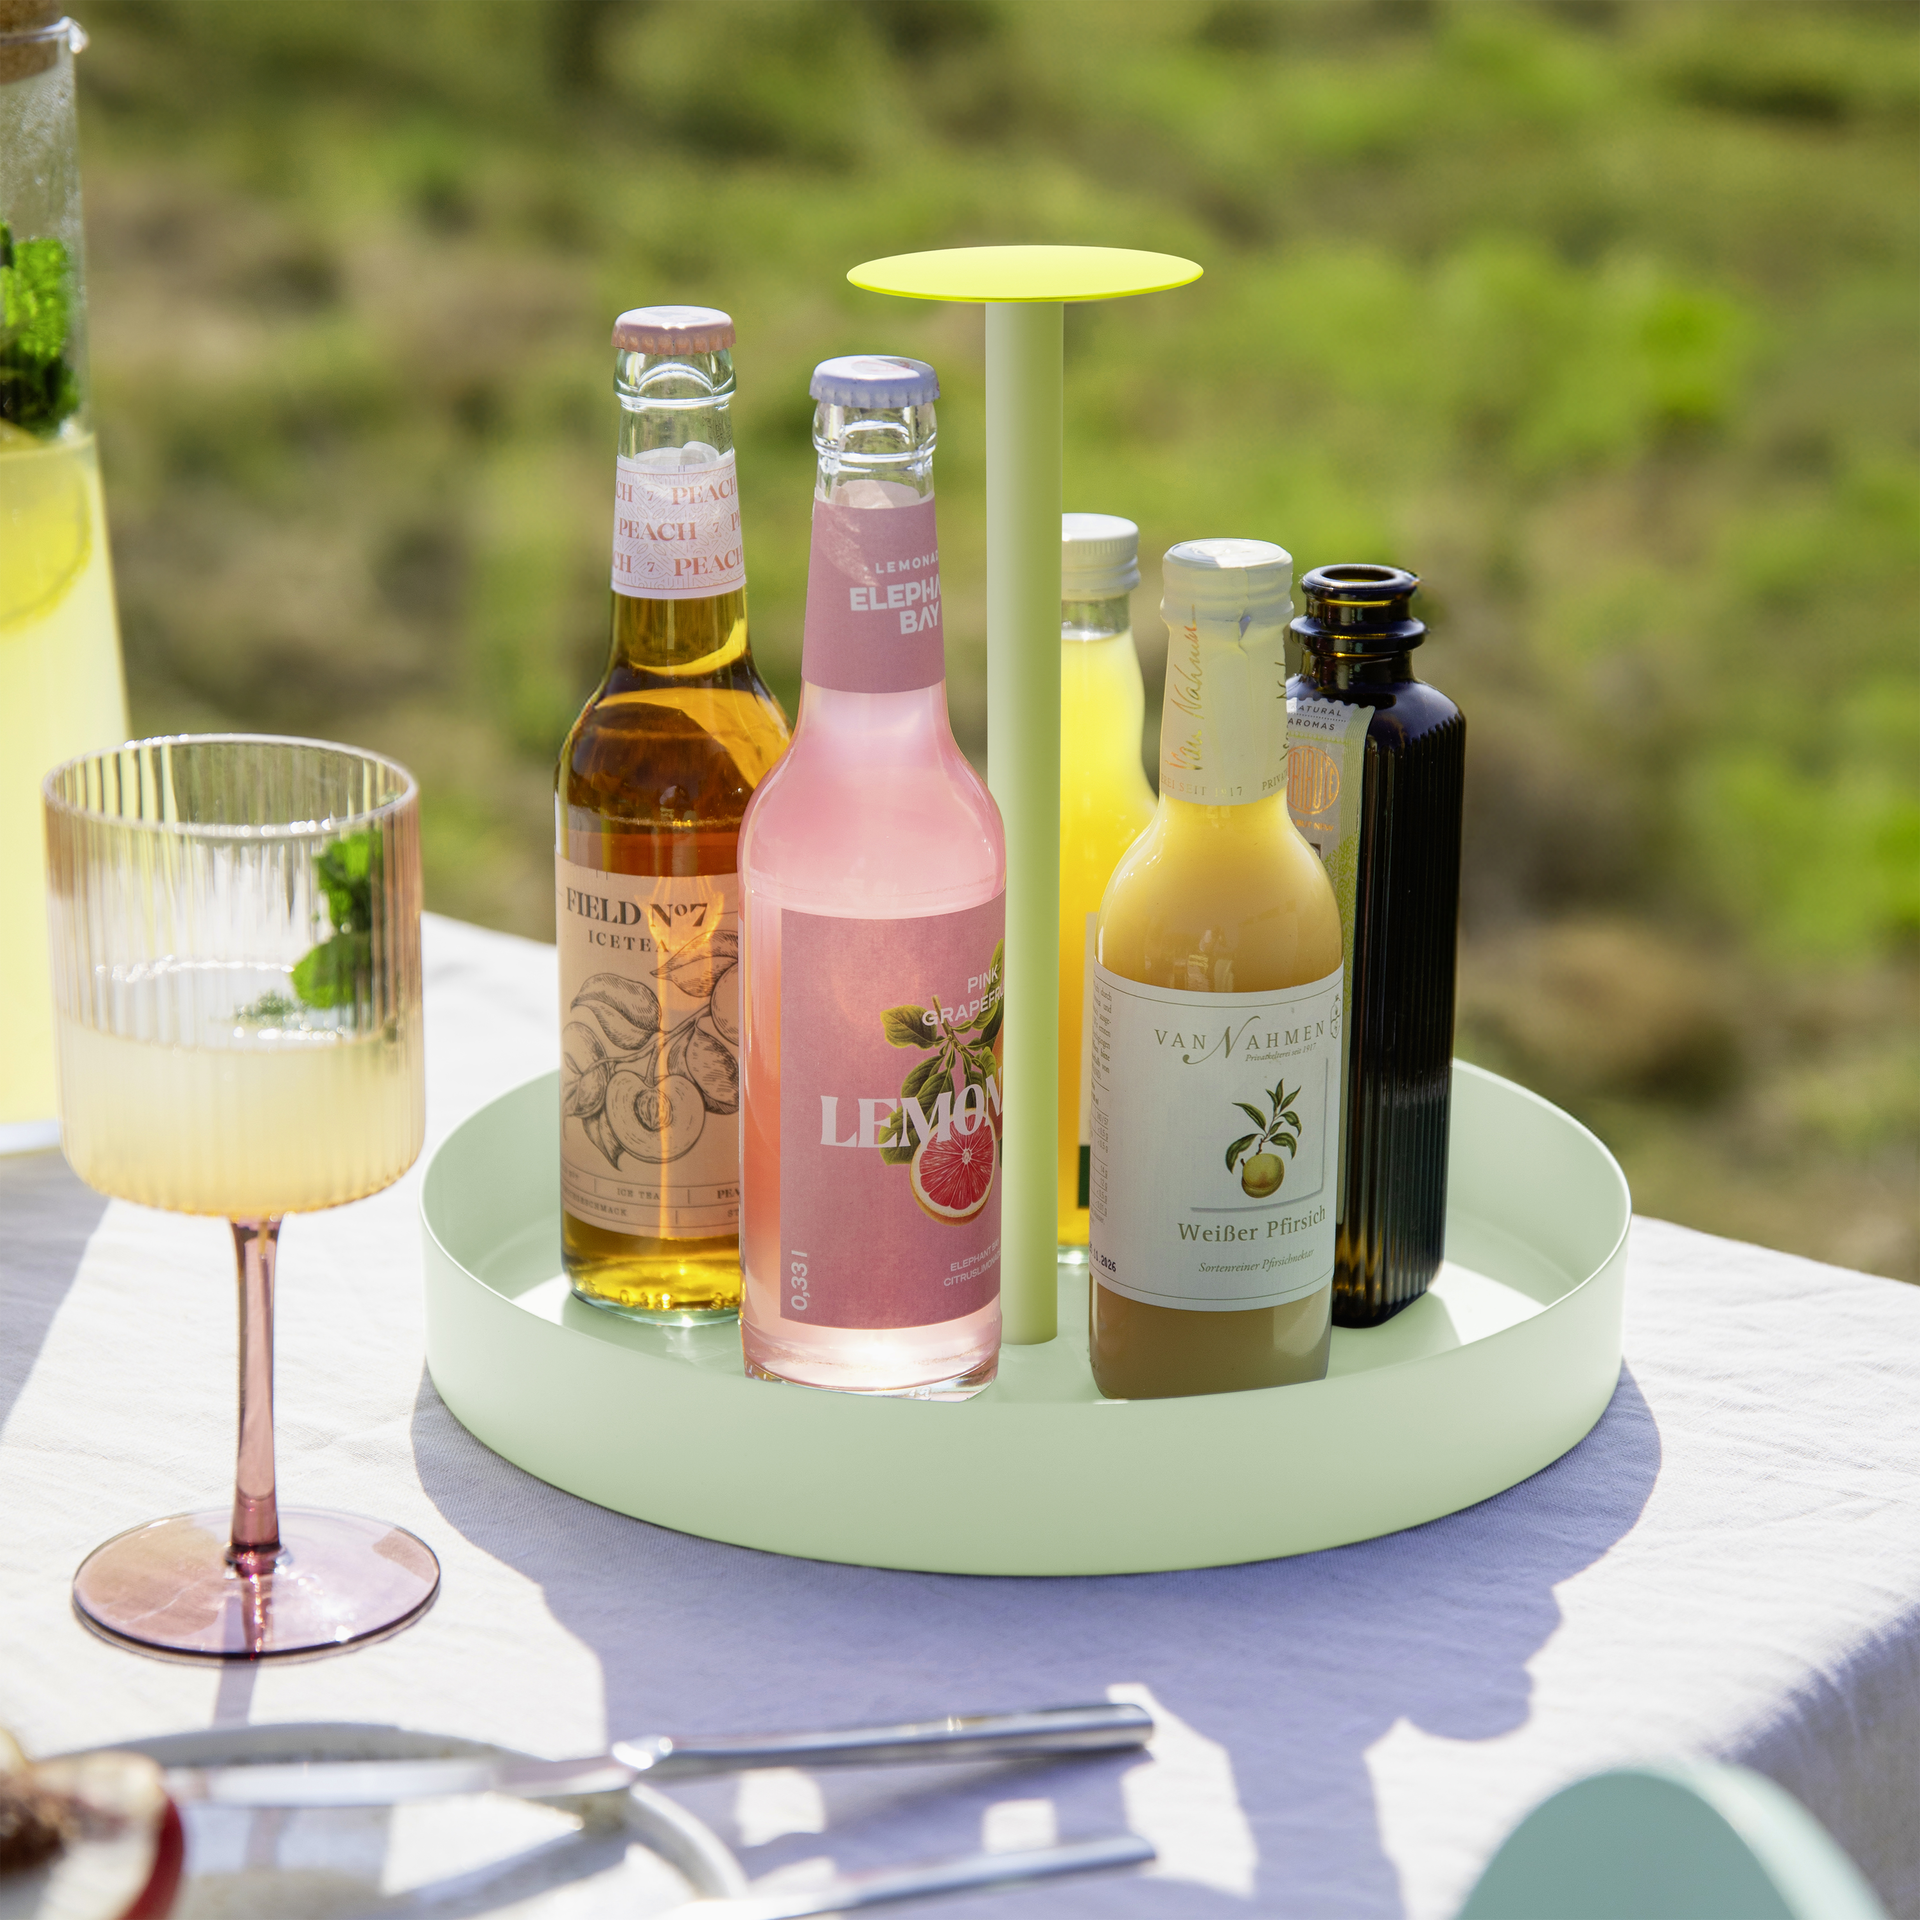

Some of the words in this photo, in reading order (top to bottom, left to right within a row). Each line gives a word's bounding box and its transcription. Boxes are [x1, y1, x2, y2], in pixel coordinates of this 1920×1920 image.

[647, 491, 655, 501] 7
[672, 475, 737, 505] PEACH
[619, 517, 697, 541] PEACH
[713, 522, 719, 533] 7
[647, 562, 655, 572] 7
[674, 545, 743, 576] PEACH
[900, 601, 939, 635] BAY
[1288, 717, 1335, 731] AROMAS
[1180, 783, 1206, 796] SEIT
[1314, 821, 1334, 831] NEW
[566, 887, 641, 925] FIELD
[967, 964, 999, 994] PINK
[1154, 1028, 1207, 1050] VAN
[1182, 1015, 1325, 1065] NAHMEN
[617, 1188, 633, 1198] ICE
[638, 1191, 661, 1200] TEA
[1177, 1222, 1259, 1242] Weißer
[1266, 1205, 1326, 1239] Pfirsich
[950, 1245, 991, 1272] ELEPHANT
[1199, 1261, 1261, 1273] Sortenreiner
[1262, 1249, 1315, 1270] Pfirsichnektar
[791, 1262, 810, 1311] 0,33
